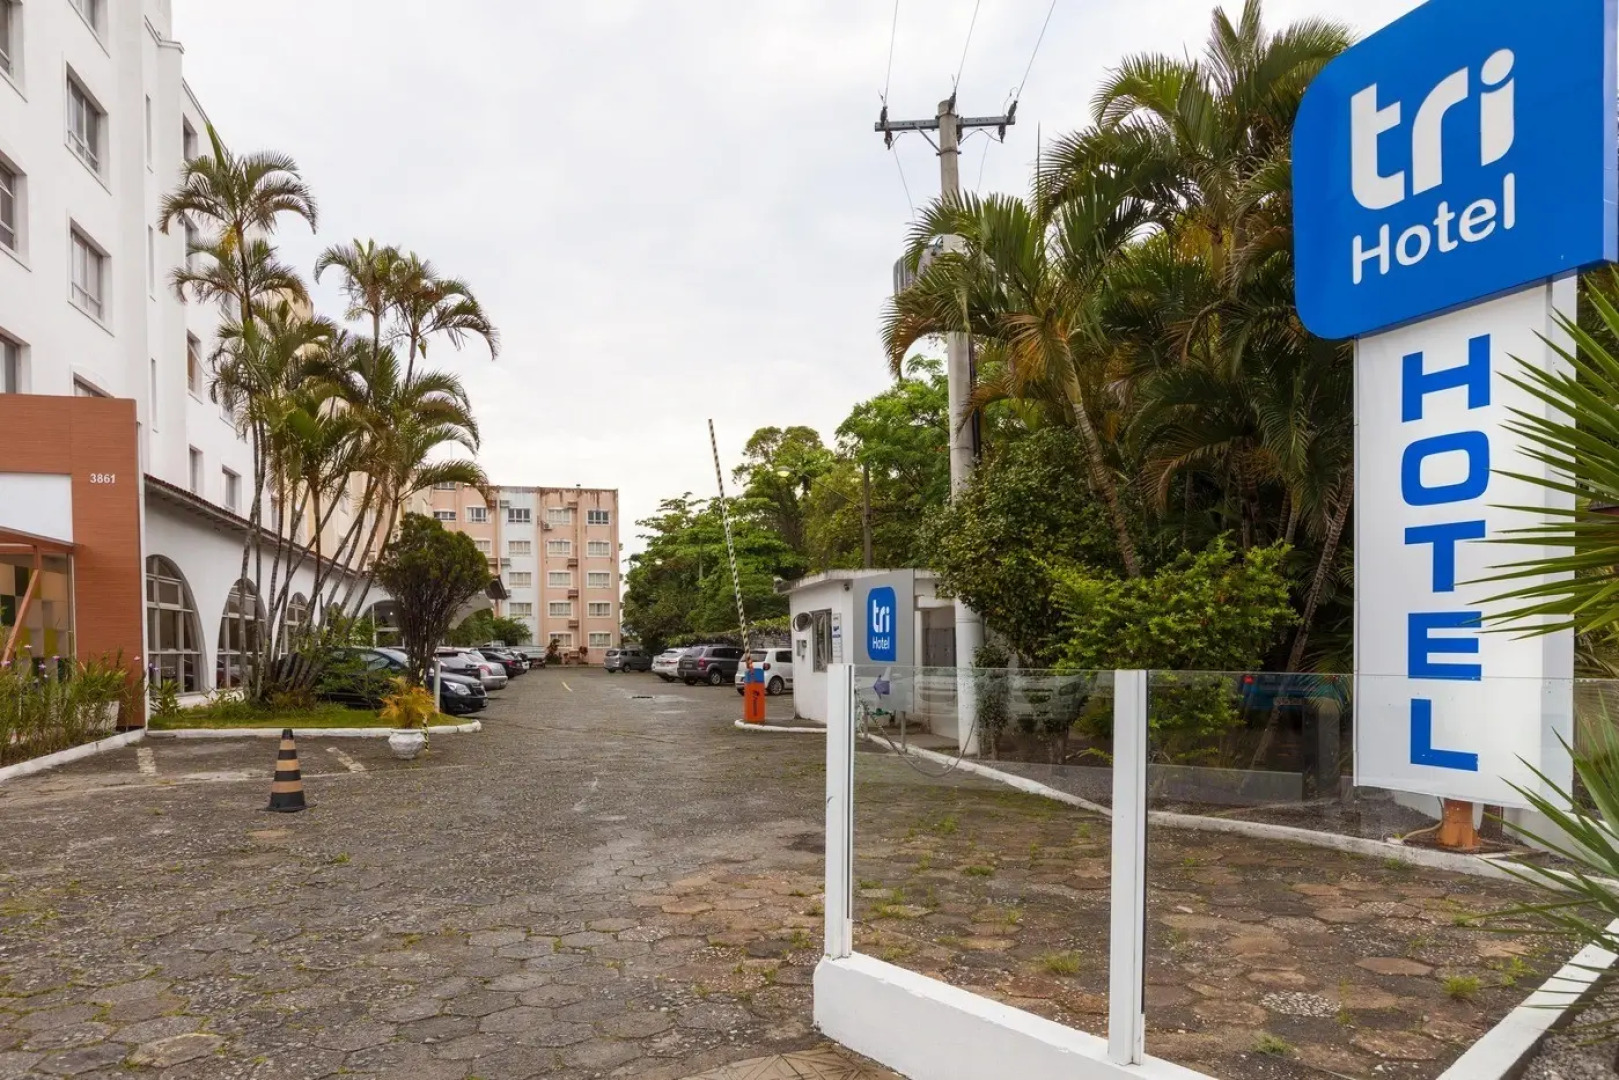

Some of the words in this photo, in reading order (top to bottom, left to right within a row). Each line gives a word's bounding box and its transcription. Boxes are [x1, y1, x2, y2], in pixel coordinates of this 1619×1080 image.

[1350, 48, 1515, 210] tri
[1352, 172, 1515, 285] Hotel
[90, 473, 116, 484] 3861
[1401, 334, 1490, 772] HOTEL
[872, 599, 890, 633] tri
[872, 636, 890, 650] Hotel
